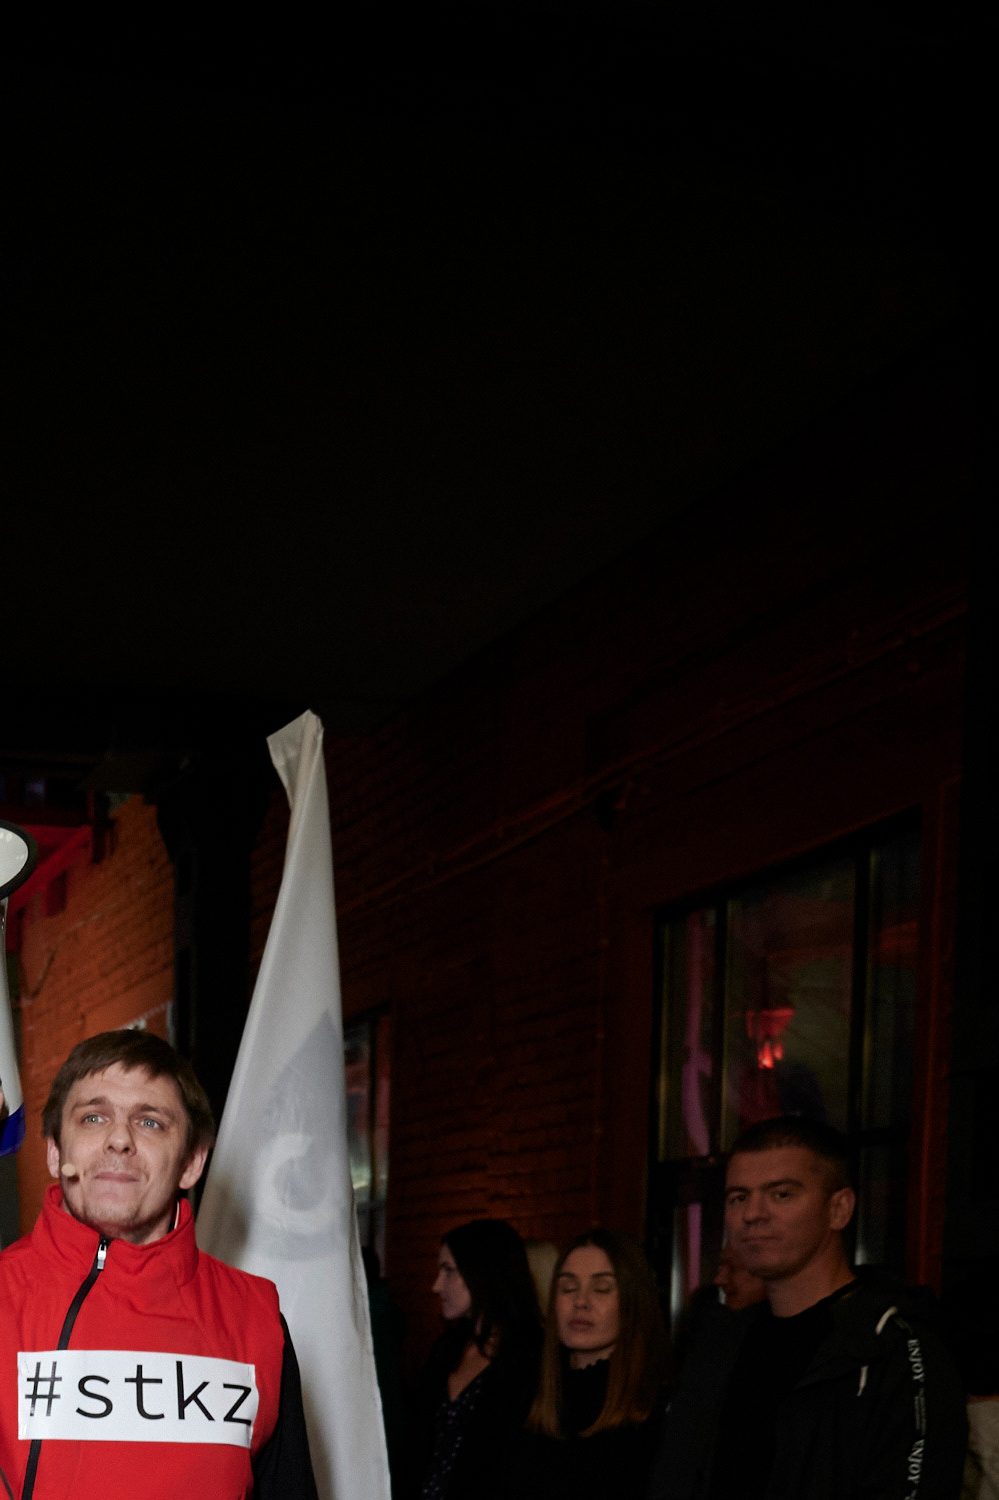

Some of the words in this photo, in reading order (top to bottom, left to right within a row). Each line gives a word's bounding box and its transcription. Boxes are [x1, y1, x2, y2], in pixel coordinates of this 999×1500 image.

[907, 1339, 925, 1383] ENJOY
[25, 1360, 252, 1426] #stkz
[907, 1439, 925, 1485] ENJOY
